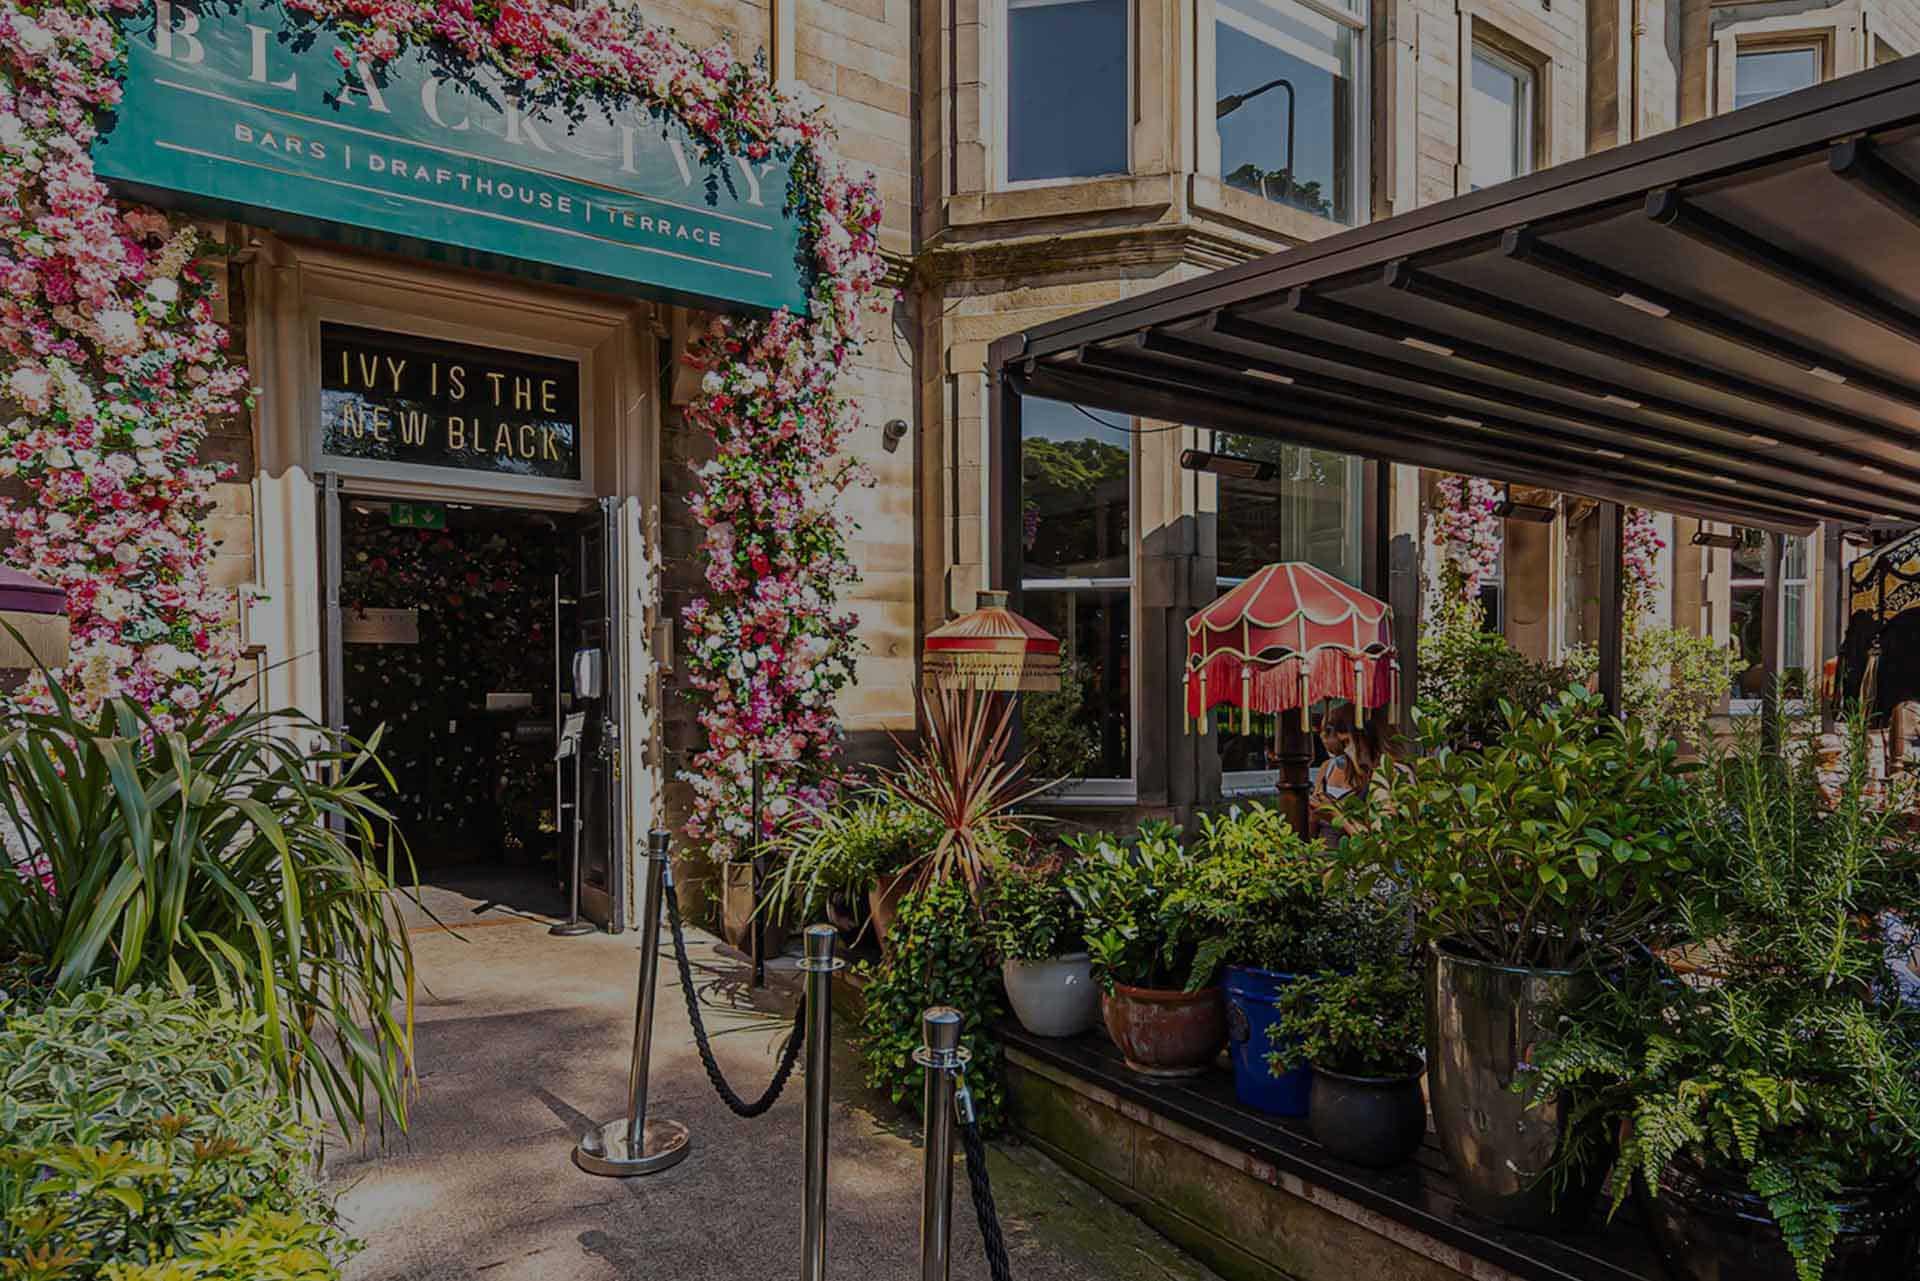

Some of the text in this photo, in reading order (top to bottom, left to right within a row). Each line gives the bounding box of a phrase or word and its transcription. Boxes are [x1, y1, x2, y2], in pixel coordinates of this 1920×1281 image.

[153, 0, 555, 153] BLACK
[234, 123, 326, 159] BARS
[368, 154, 572, 214] DRAFTHOUSE
[607, 207, 721, 247] TERRACE
[343, 351, 558, 414] IVY IS THE
[343, 402, 560, 462] NEW BLACK
